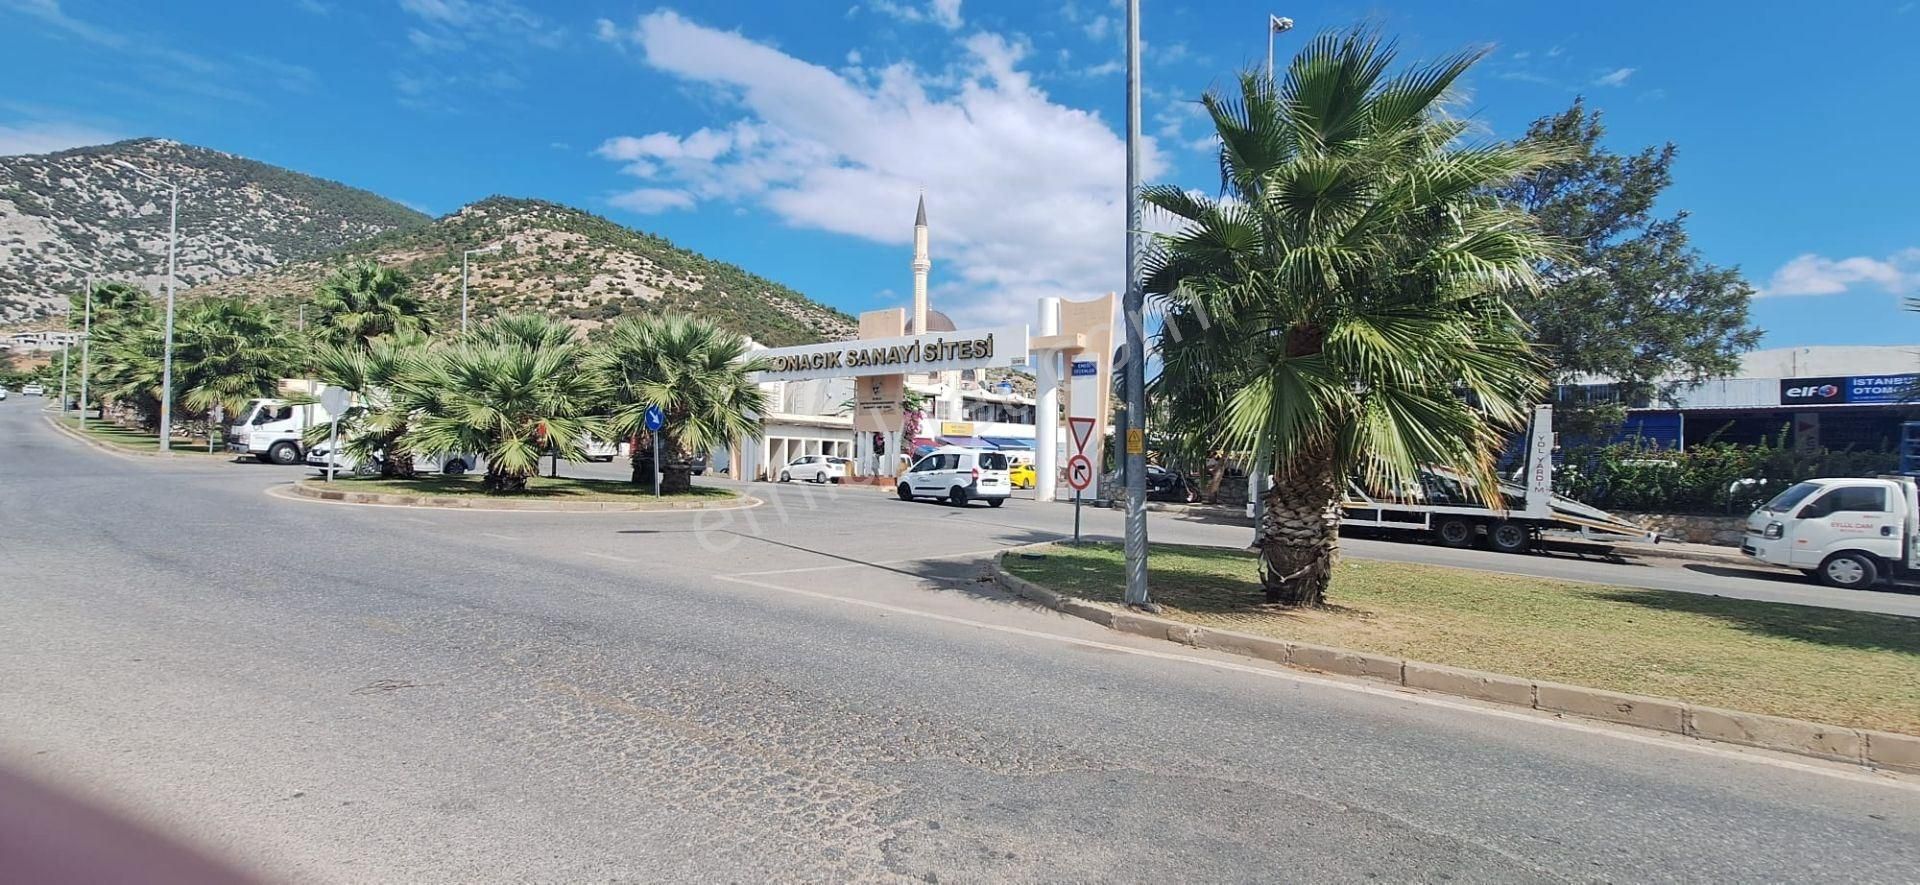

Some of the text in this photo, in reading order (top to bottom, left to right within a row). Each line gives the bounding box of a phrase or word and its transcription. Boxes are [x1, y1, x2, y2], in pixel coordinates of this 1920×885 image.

[845, 339, 920, 367] SANAYİ
[923, 333, 994, 362] SİTESİ
[1786, 386, 1819, 397] elf
[1534, 435, 1546, 493] YOL YARDIM
